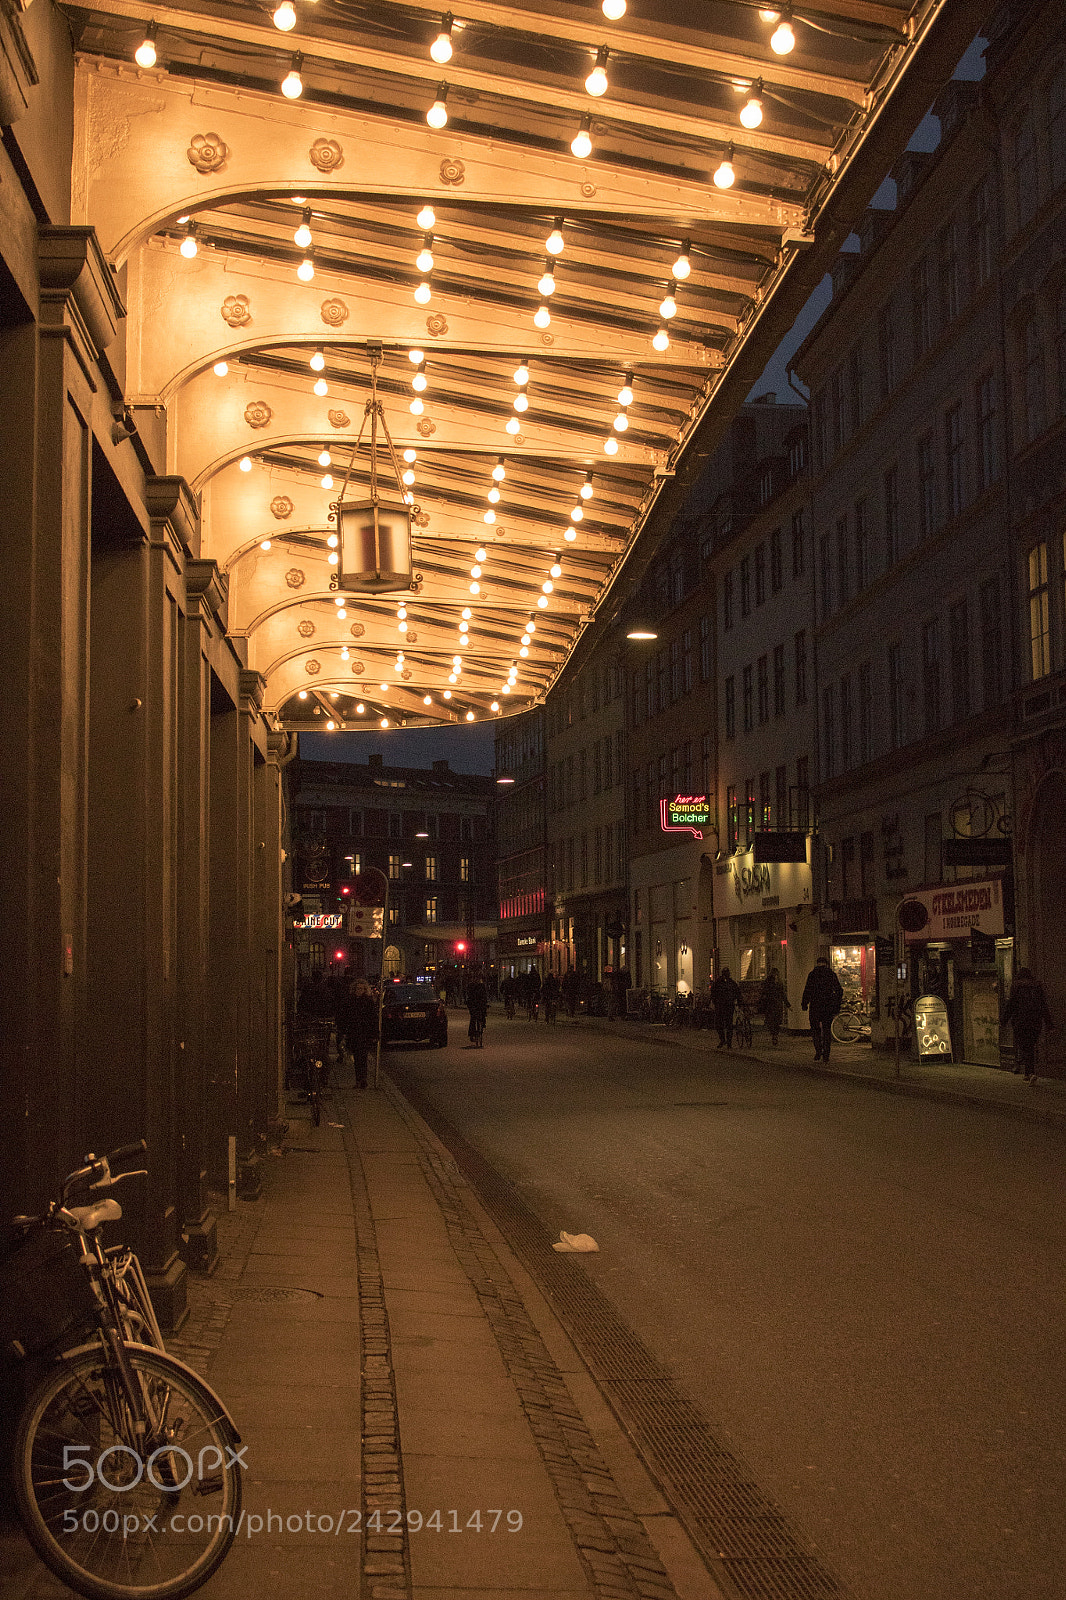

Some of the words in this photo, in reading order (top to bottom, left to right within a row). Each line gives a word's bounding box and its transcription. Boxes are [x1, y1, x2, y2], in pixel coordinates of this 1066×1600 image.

[674, 794, 693, 803] her
[692, 795, 706, 803] er
[669, 802, 710, 812] Sømod's
[672, 812, 709, 822] Bolcher
[323, 916, 340, 926] CUT
